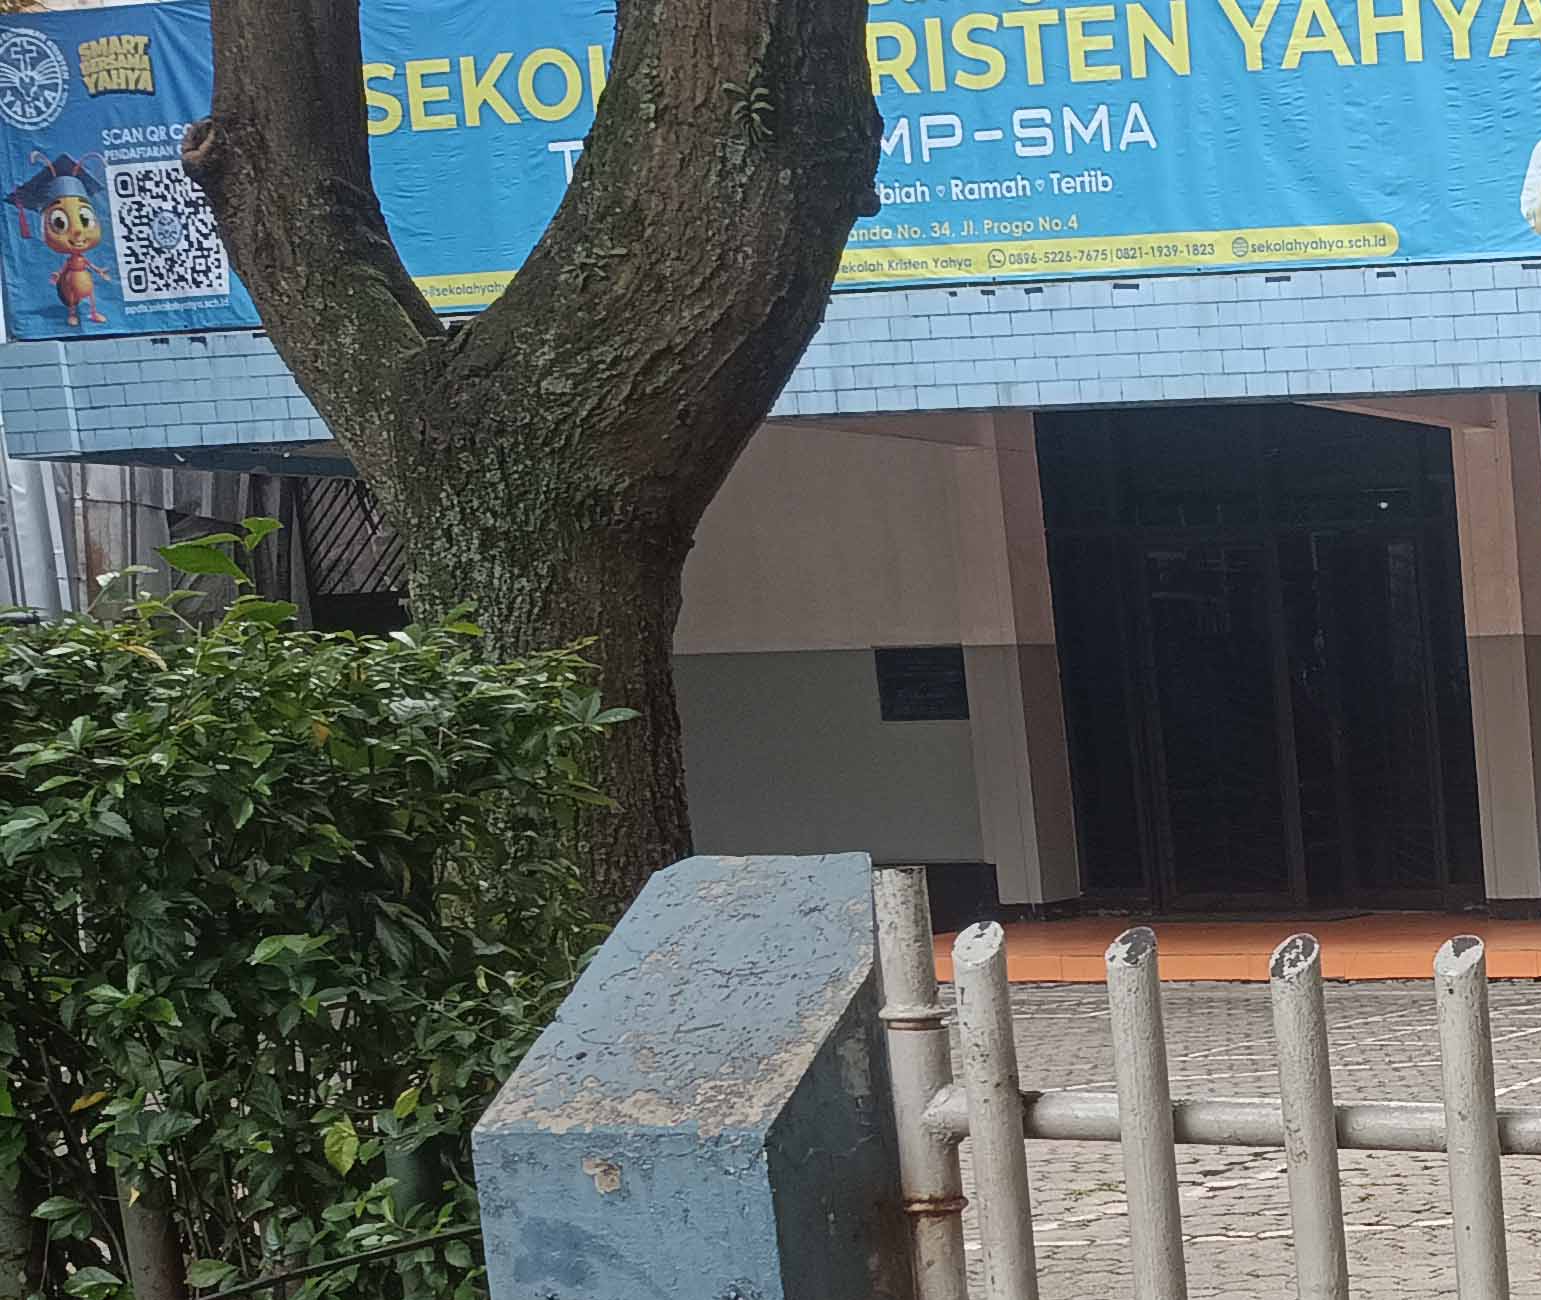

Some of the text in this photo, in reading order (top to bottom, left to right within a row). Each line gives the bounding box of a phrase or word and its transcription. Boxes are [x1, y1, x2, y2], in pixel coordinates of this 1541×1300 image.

[79, 35, 149, 57] SMART
[363, 45, 607, 136] SEKO
[866, 0, 1191, 97] RISTEN
[83, 69, 154, 95] YAHYA
[102, 127, 143, 145] SCAN
[146, 126, 167, 141] QR
[880, 101, 1158, 165] MP-SMA
[875, 169, 1114, 205] biah Ramah Tertib
[847, 225, 892, 241] anda
[896, 223, 927, 240] No.
[983, 218, 1033, 235] Progo
[839, 261, 884, 274] ekolah
[887, 258, 928, 272] Kristen
[933, 256, 972, 270] Yahya
